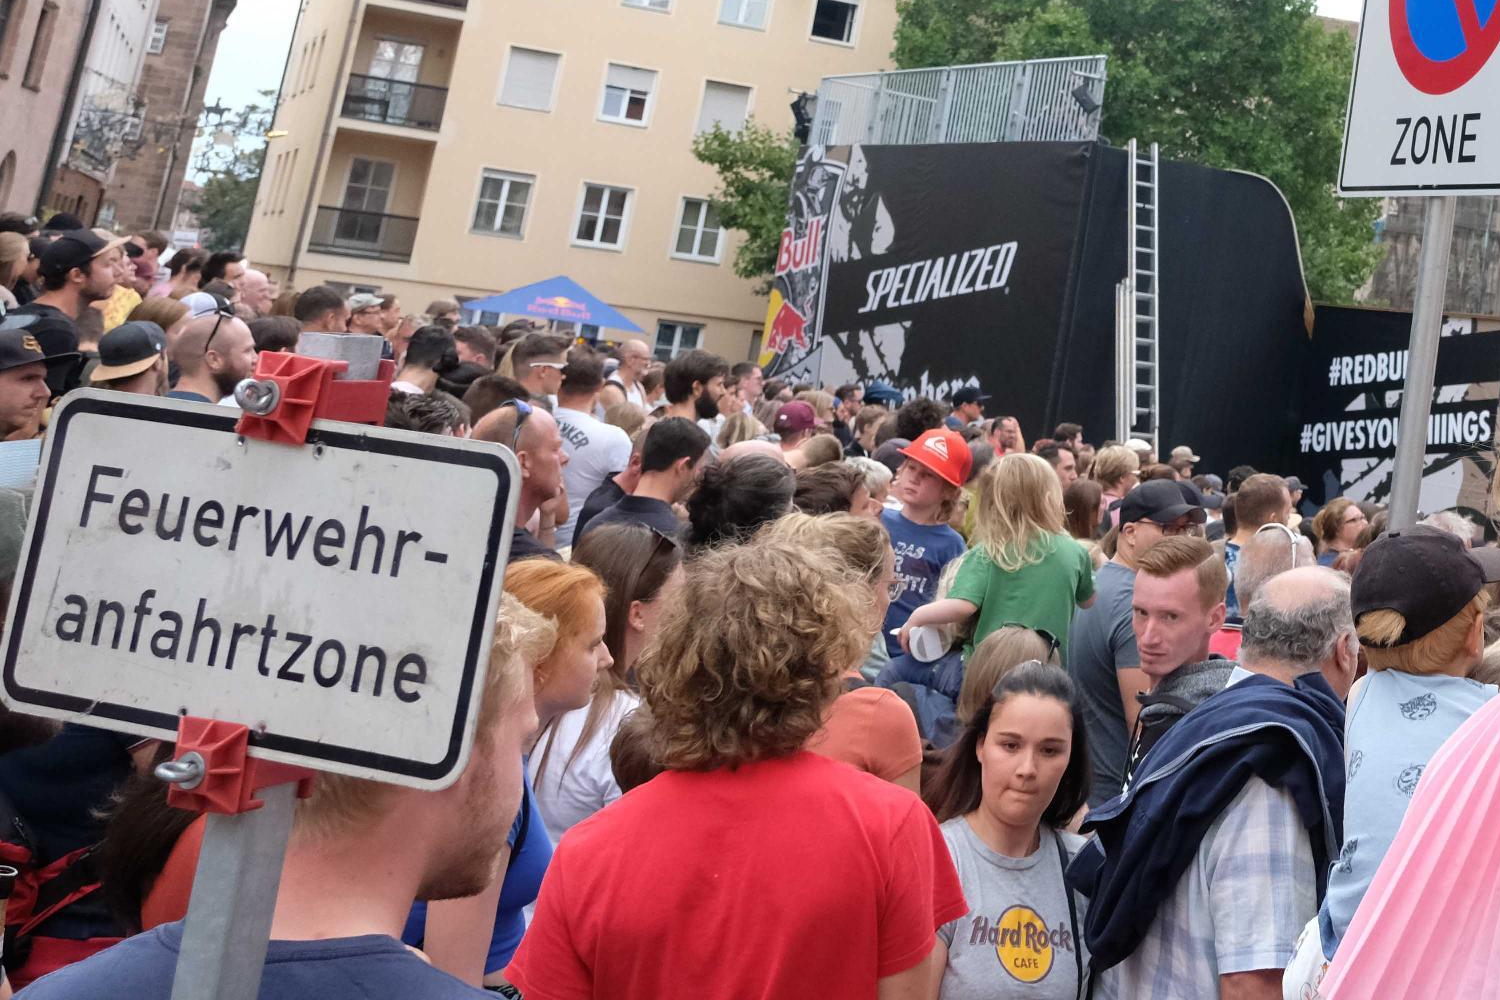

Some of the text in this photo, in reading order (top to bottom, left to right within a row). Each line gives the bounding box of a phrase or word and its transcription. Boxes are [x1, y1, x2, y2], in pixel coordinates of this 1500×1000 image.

[1390, 112, 1481, 165] ZONE
[775, 216, 822, 275] Bull
[857, 241, 1018, 314] SPECIALIZED
[78, 464, 449, 578] Feuerwehr-
[55, 588, 428, 703] anfahrtzone
[969, 915, 1075, 954] Hard Rock
[1013, 957, 1040, 969] CAFE
